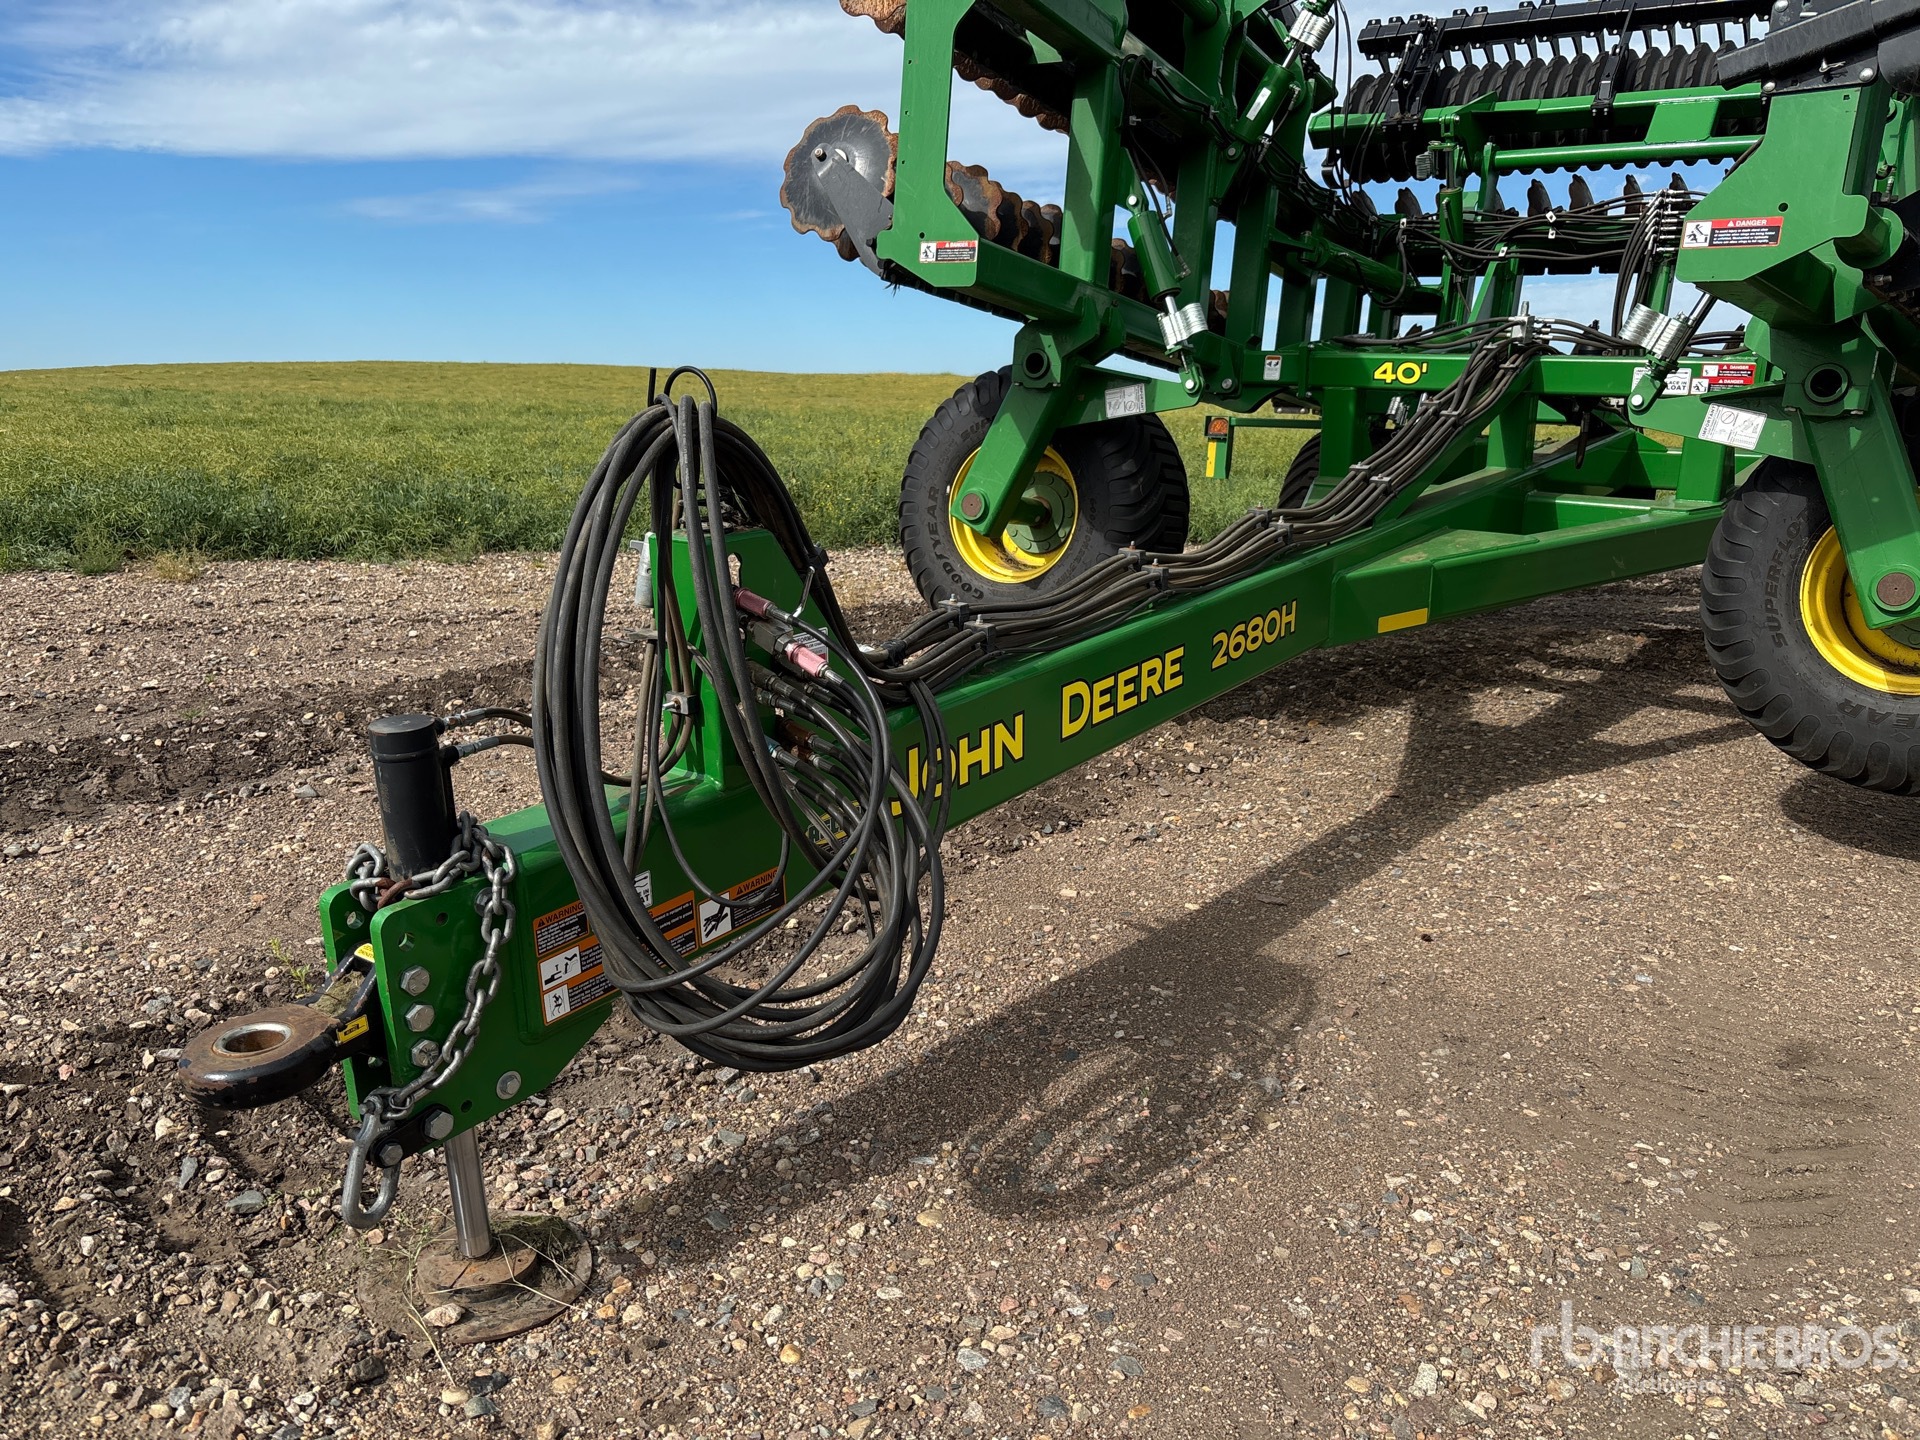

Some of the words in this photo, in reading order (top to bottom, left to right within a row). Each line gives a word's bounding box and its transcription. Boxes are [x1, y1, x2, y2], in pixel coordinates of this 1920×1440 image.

[1736, 219, 1768, 227] DANGER
[1373, 361, 1428, 385] 40'
[1702, 406, 1716, 437] IMPORTANT
[928, 486, 984, 600] GOODYEAR
[1061, 643, 1185, 742] DEERE
[1211, 599, 1297, 671] 2680H
[545, 902, 584, 924] WARNING
